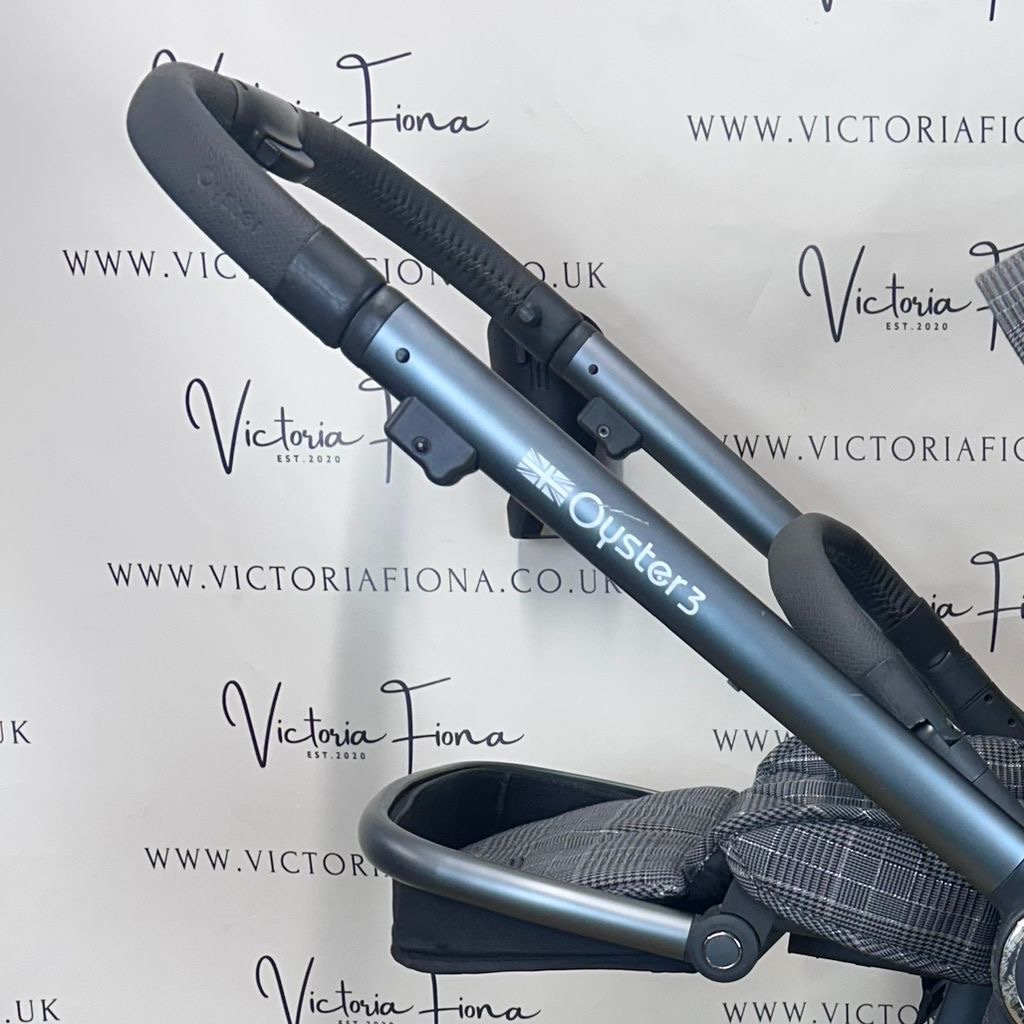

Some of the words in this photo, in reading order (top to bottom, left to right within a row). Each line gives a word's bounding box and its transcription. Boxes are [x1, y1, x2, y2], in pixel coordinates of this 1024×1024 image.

[337, 51, 490, 149] Fiona
[798, 244, 972, 343] Victoria
[886, 322, 949, 331] EST.2020
[185, 378, 364, 475] Victoria
[277, 454, 341, 464] EST.2020
[222, 680, 388, 768] Victoria
[380, 677, 525, 773] Fiona
[307, 751, 367, 760] EST.2020
